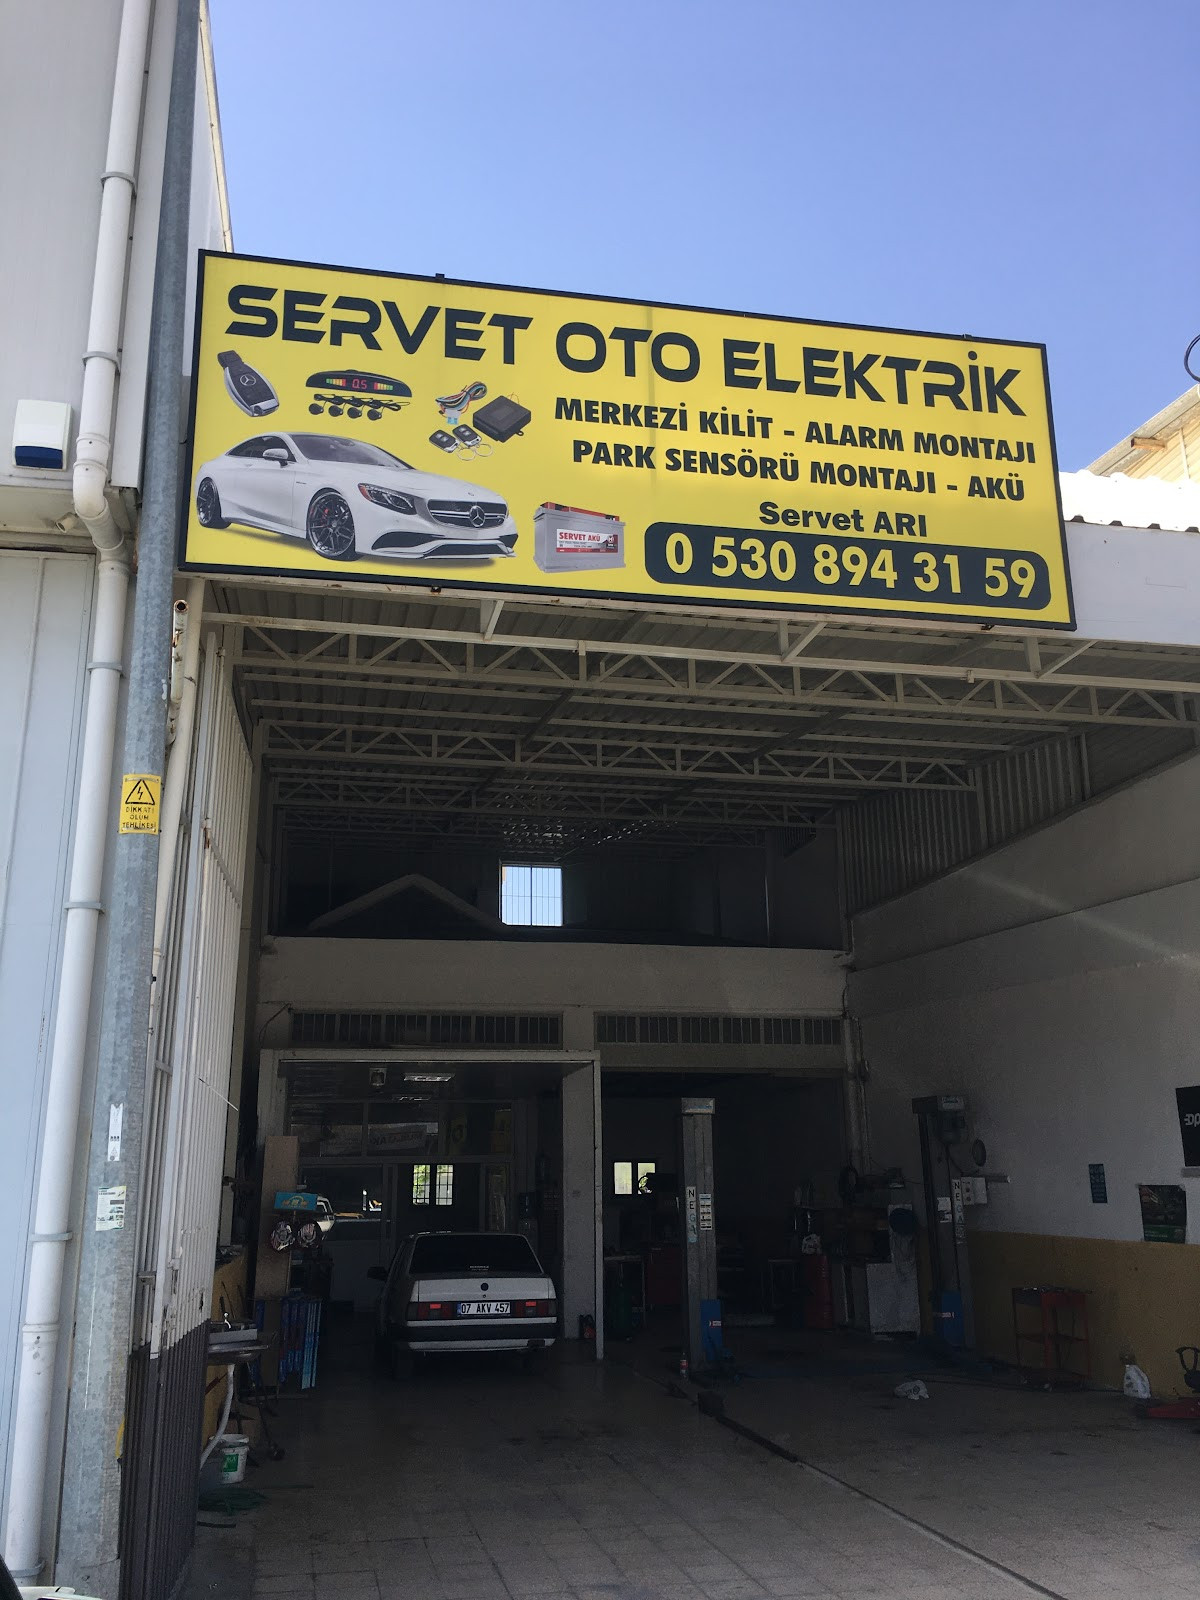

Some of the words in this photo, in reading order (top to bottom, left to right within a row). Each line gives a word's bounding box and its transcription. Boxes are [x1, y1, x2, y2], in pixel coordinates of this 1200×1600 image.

[225, 284, 534, 366] SERVET
[556, 322, 701, 383] OTO
[722, 338, 1027, 417] ELEKTRİK
[555, 397, 688, 432] MERKEZİ
[700, 406, 773, 439] KİLİT
[805, 421, 905, 452] ALARM
[914, 431, 1036, 464] MONTAJI
[573, 440, 656, 470] PARK
[665, 448, 800, 482] SENSÖRÜ
[810, 461, 937, 494] MONTAJI
[968, 473, 1025, 502] AKÜ
[559, 532, 586, 541] SERVET
[759, 501, 864, 533] Servet
[874, 511, 928, 539] ARI
[665, 532, 693, 574] 0
[712, 536, 797, 582] 530
[813, 543, 898, 589] 894
[913, 551, 961, 594] 31
[985, 557, 1036, 598] 59
[461, 1303, 471, 1313] 07
[476, 1303, 492, 1313] AKV
[494, 1303, 510, 1312] 457
